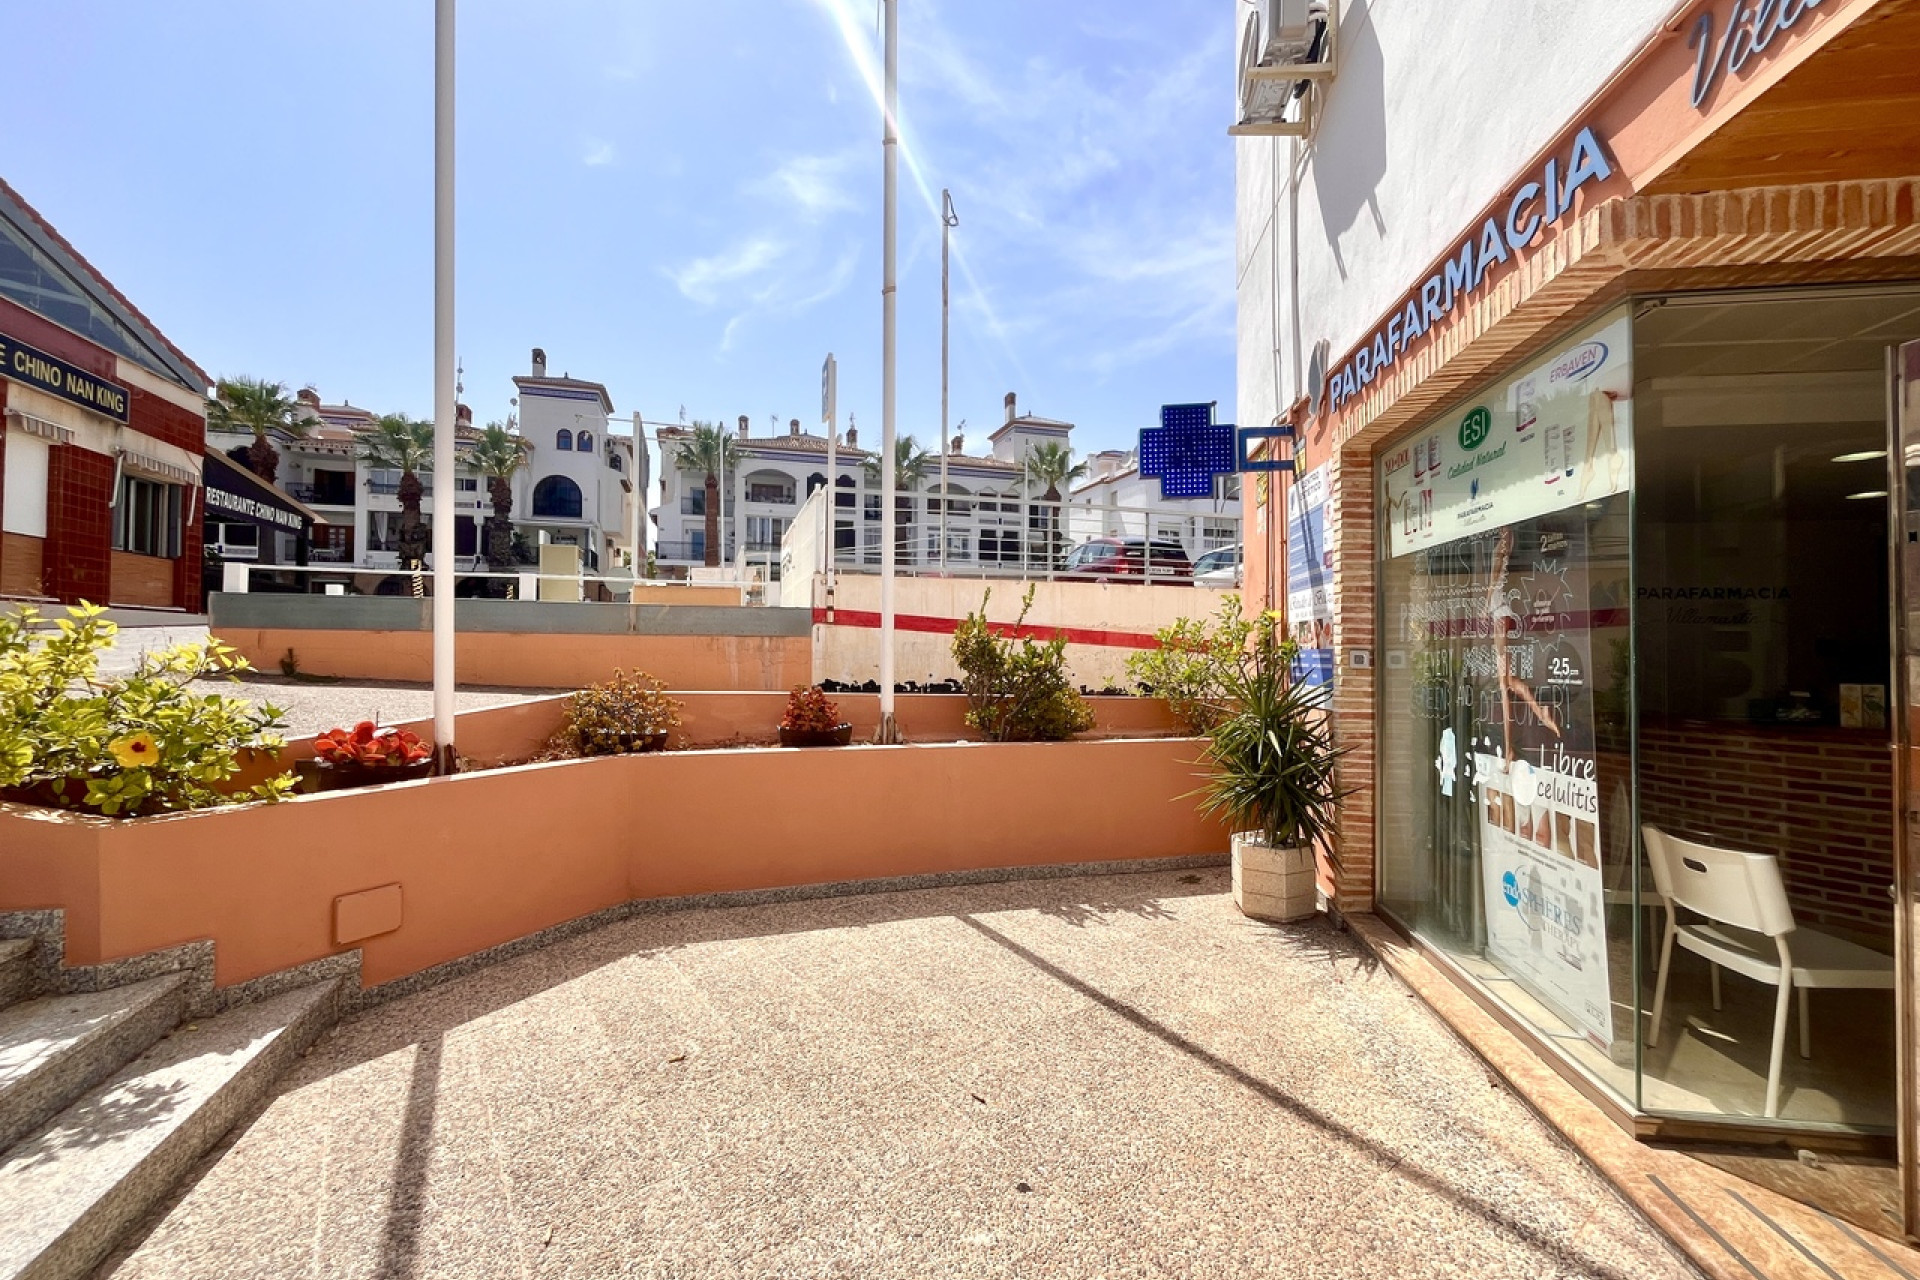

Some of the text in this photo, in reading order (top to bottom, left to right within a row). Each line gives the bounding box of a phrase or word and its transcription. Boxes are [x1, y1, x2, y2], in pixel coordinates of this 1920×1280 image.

[1330, 126, 1611, 413] PARAFARMACIA
[14, 351, 61, 387] CHINO
[66, 372, 94, 401] NAN
[96, 386, 124, 413] KING
[1550, 347, 1598, 383] ERBAVEN
[1463, 411, 1486, 446] ESI
[205, 486, 256, 516] RESTAURANTE
[1637, 587, 1791, 600] PARAFARMACIA
[1541, 742, 1596, 781] Libre
[1537, 778, 1597, 814] celulitis
